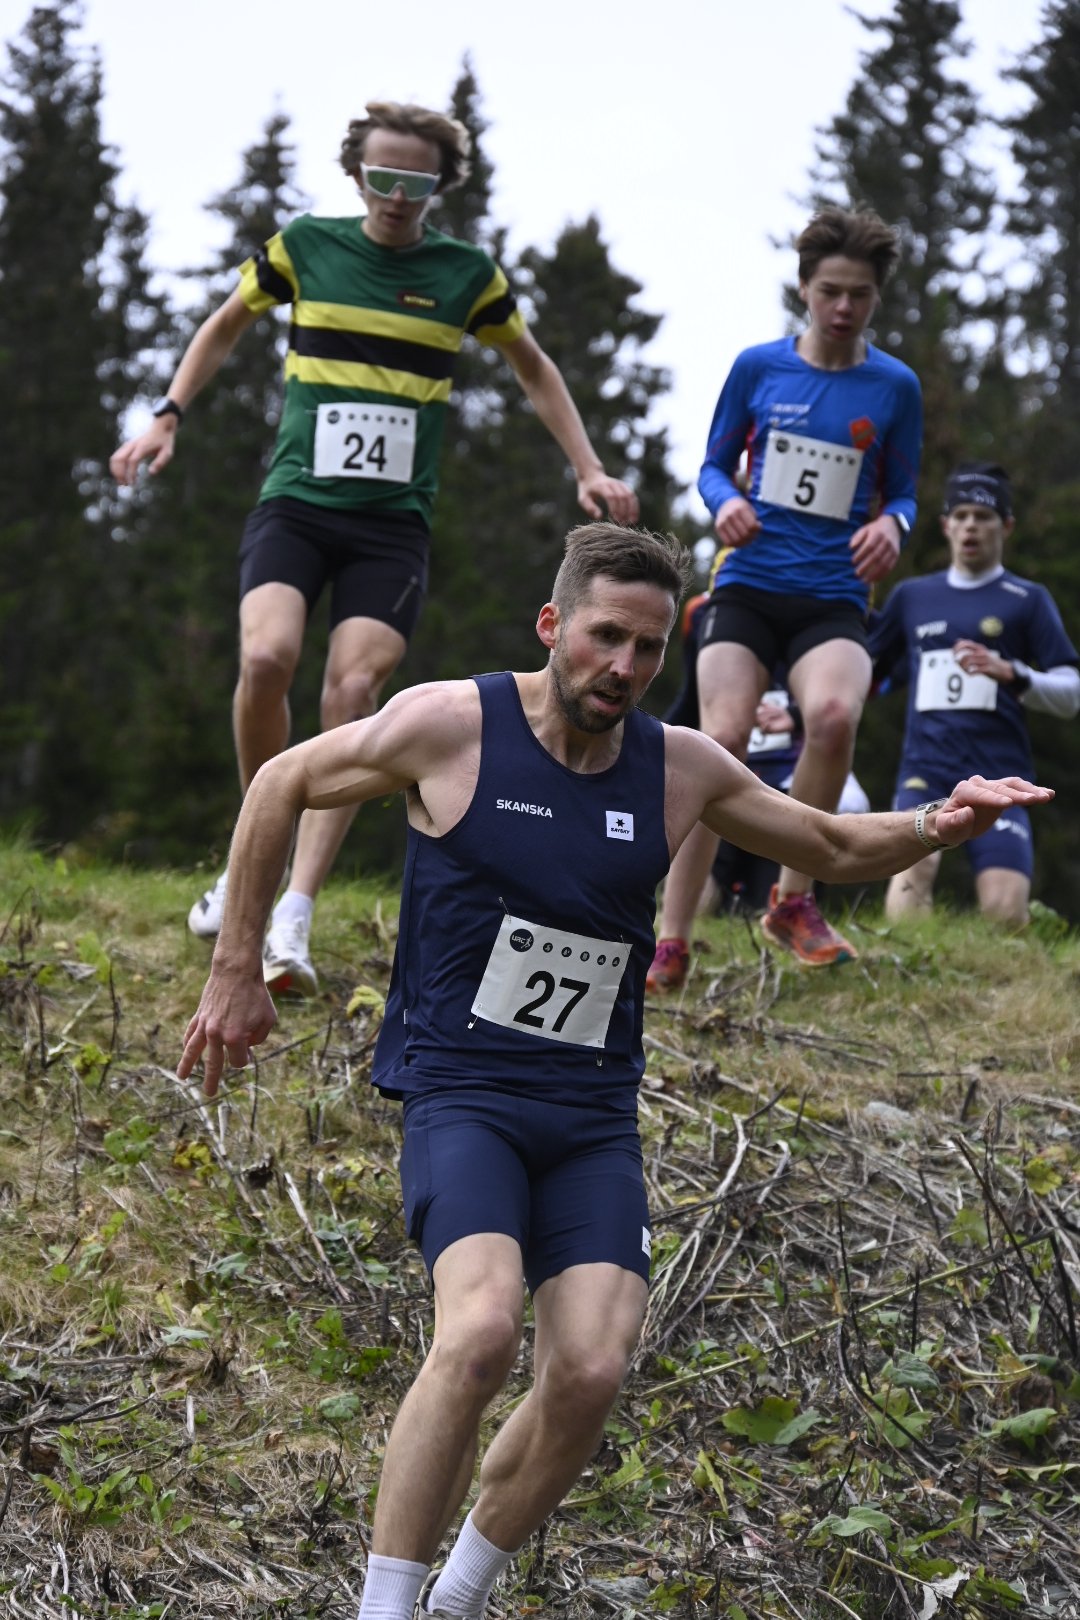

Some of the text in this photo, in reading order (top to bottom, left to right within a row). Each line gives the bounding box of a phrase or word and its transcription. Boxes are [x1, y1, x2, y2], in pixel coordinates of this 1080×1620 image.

[343, 431, 387, 473] 24
[794, 468, 819, 507] 5
[947, 673, 963, 703] 9
[496, 798, 553, 819] SKANSKA
[513, 970, 590, 1033] 27
